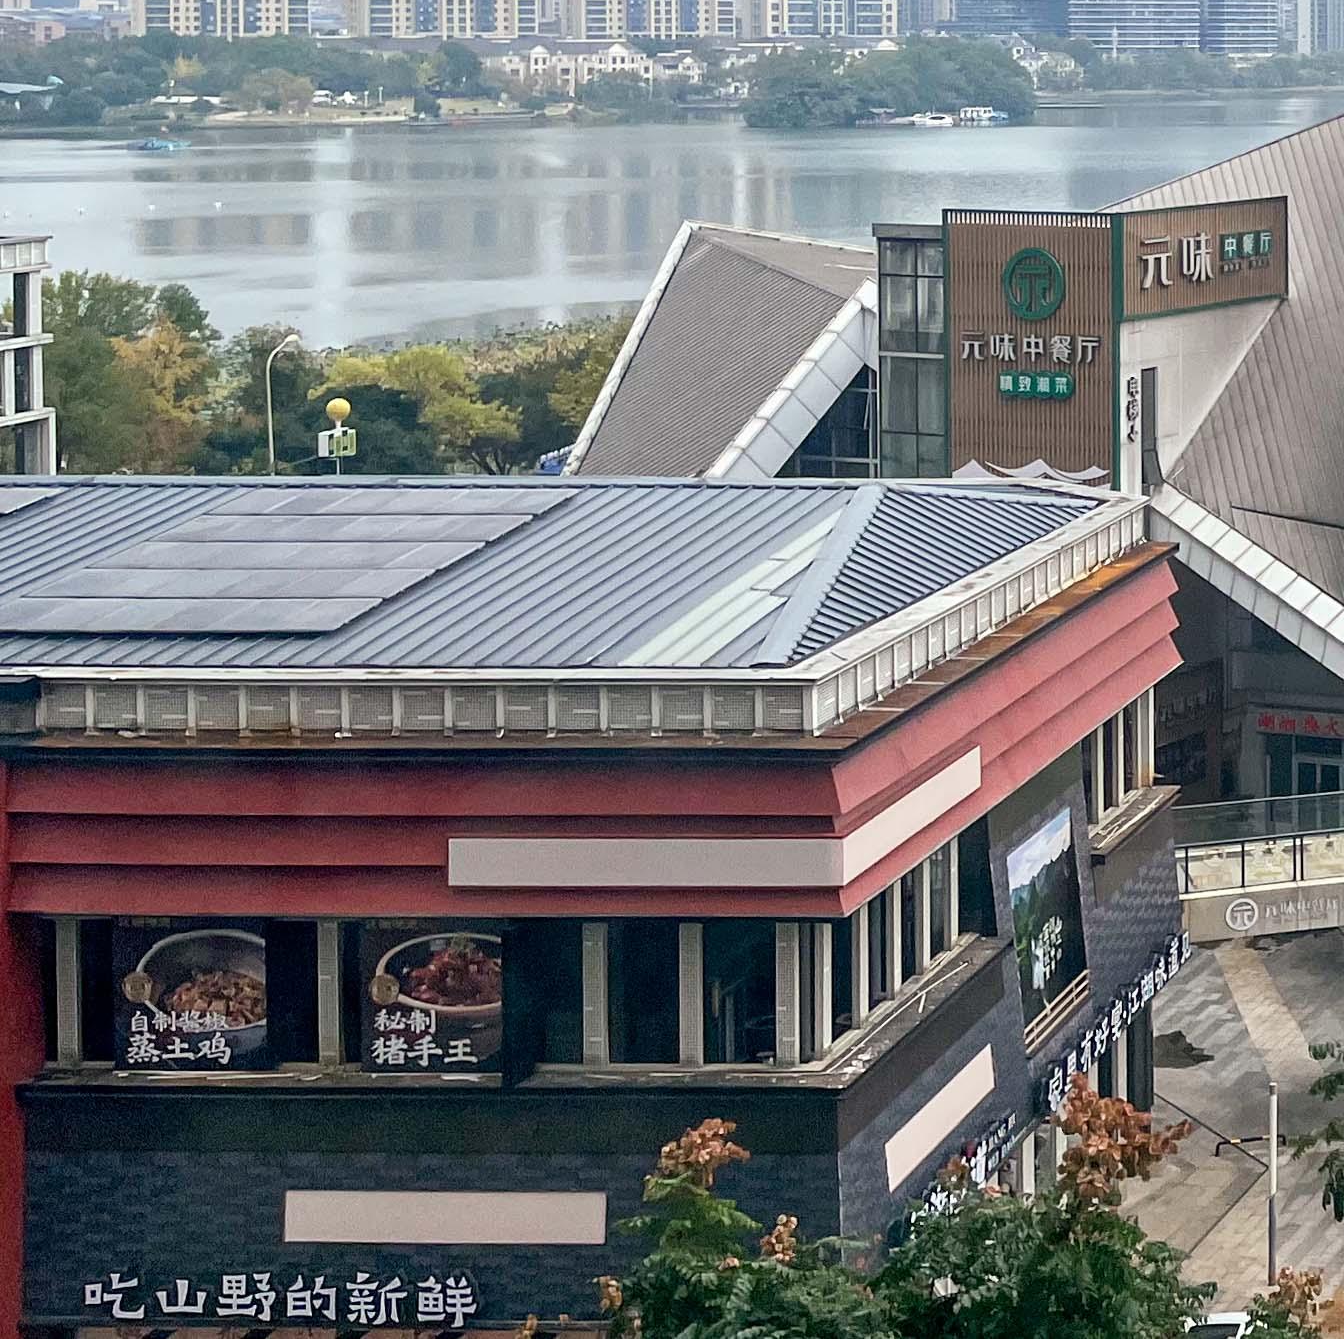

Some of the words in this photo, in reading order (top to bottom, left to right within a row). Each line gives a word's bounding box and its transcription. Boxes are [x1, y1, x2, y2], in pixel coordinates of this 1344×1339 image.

[1139, 232, 1215, 289] 元味
[1223, 232, 1272, 257] 中餐厅
[961, 331, 1100, 364] 元味中餐厅
[999, 375, 1069, 395] 精致湘菜
[131, 1011, 228, 1033] 自制酱椒
[373, 1008, 436, 1034] 秘制
[127, 1031, 231, 1065] 蒸土鸡
[370, 1034, 479, 1067] 猪手王
[84, 1272, 478, 1328] 吃山野的新鲜
